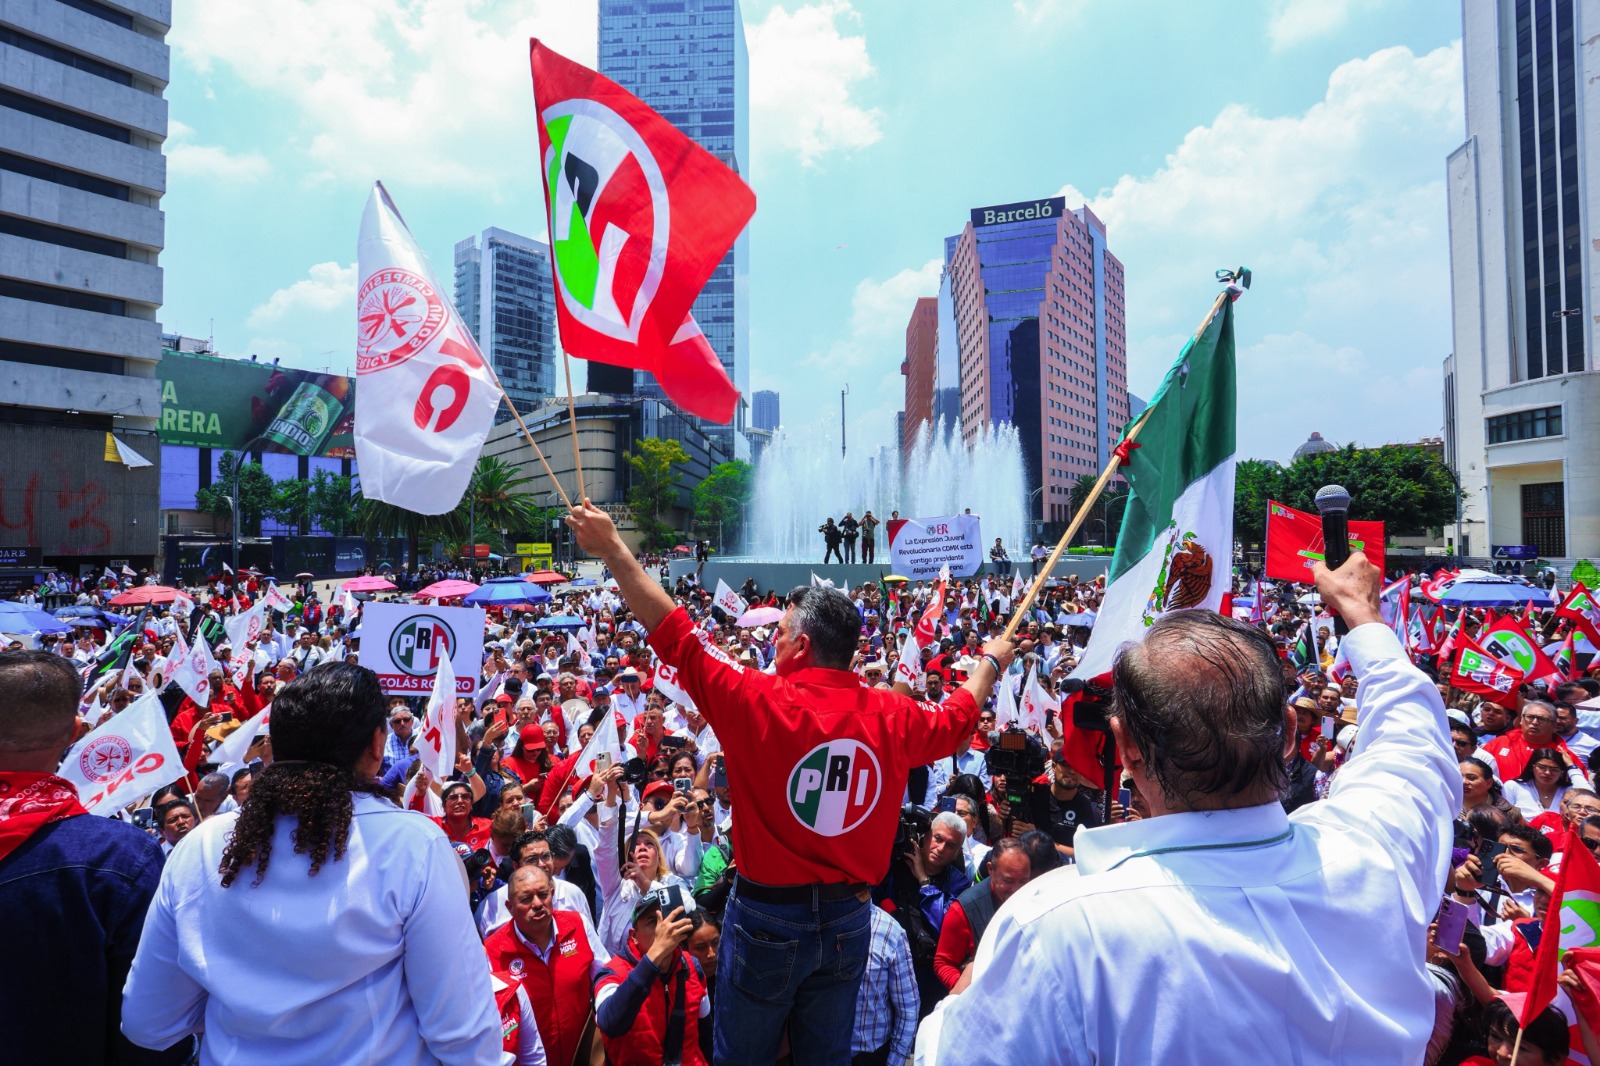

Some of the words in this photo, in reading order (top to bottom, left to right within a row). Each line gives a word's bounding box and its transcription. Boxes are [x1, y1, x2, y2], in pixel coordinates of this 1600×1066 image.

[984, 201, 1052, 225] Barceló
[271, 420, 310, 446] INDIO
[945, 534, 965, 542] Juvenil
[898, 547, 941, 555] Revolucionaria
[909, 556, 932, 565] contigo
[933, 554, 965, 563] presidente
[912, 566, 941, 575] Alejandro
[719, 598, 738, 613] CNC
[399, 627, 444, 658] PRI
[380, 675, 418, 689] COLÁS
[421, 678, 471, 690] RORO
[658, 664, 686, 692] CN
[795, 755, 869, 806] PRI
